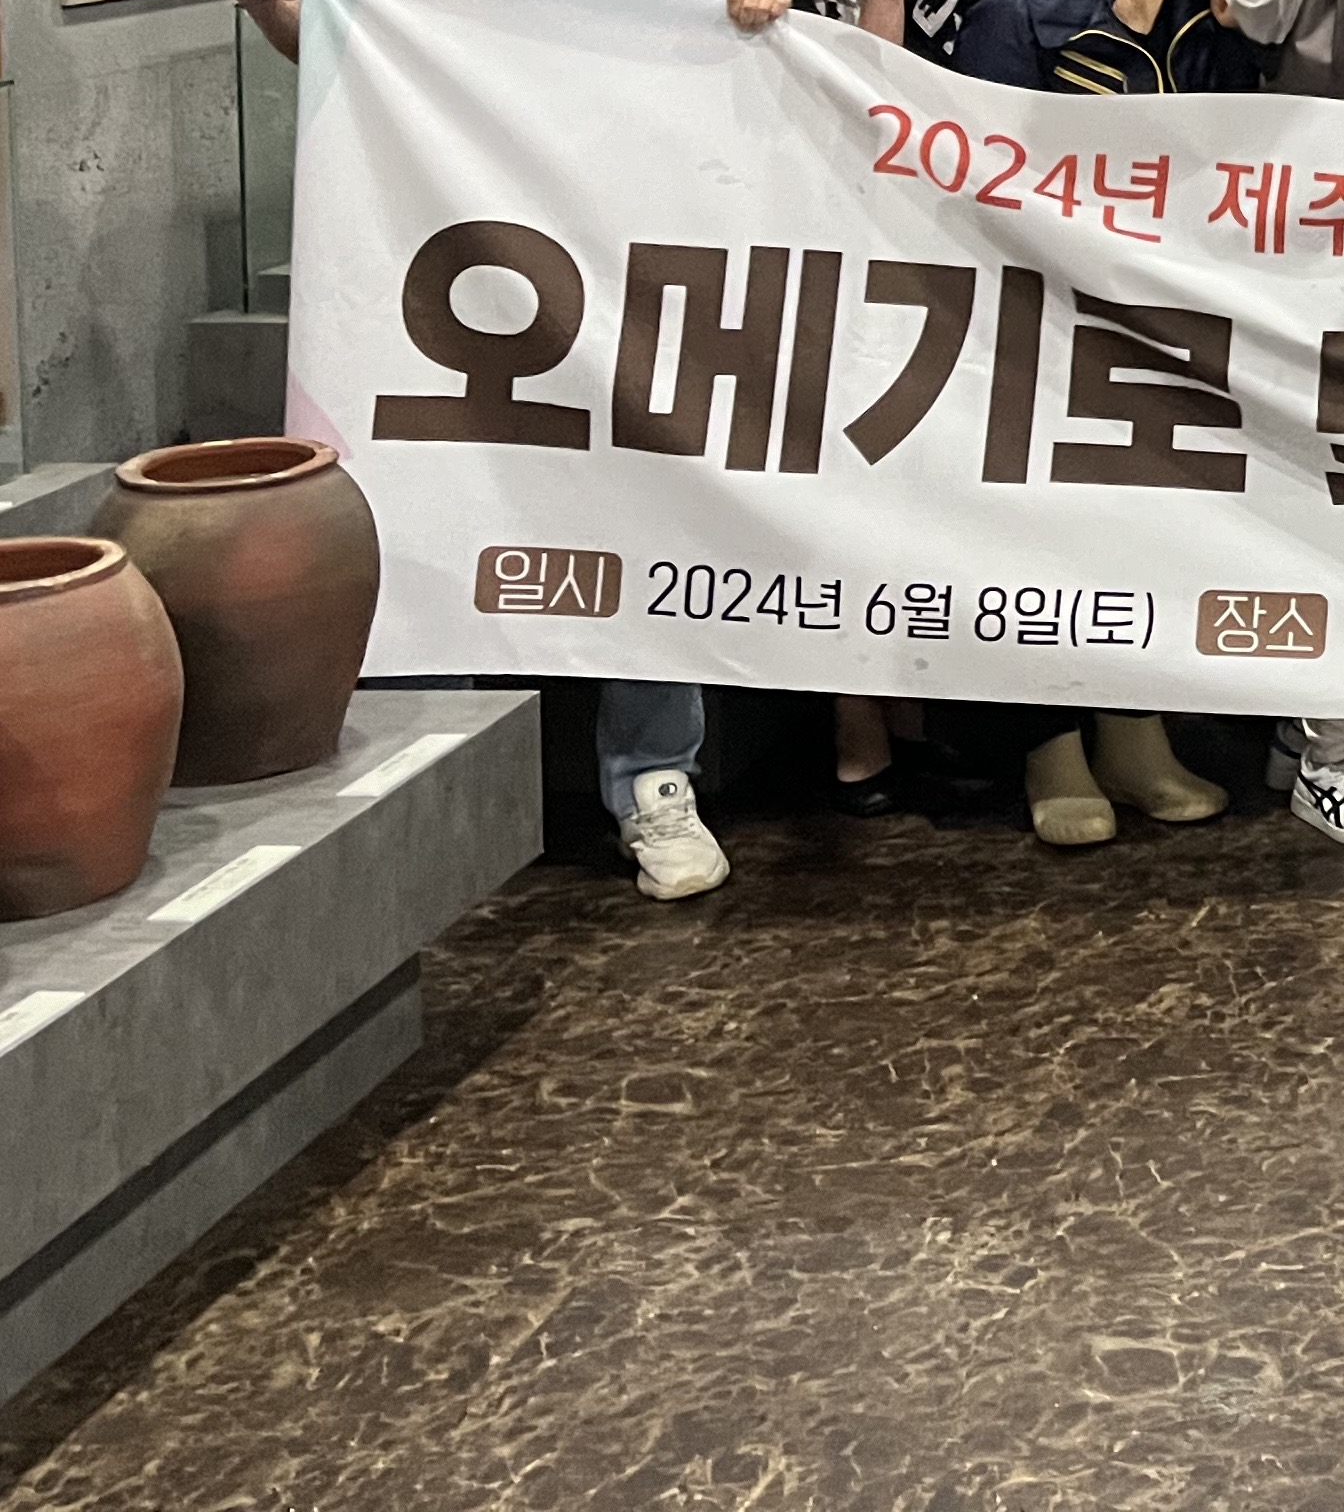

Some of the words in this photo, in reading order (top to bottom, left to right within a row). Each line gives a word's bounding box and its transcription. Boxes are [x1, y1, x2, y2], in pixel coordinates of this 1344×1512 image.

[868, 104, 1171, 244] 2024년
[372, 220, 1249, 494] 오메기로
[493, 549, 606, 615] 일시
[647, 561, 843, 632] 2024년
[865, 583, 953, 642] 6월
[974, 586, 1155, 651] 8일(토)
[1213, 597, 1317, 655] 장소
